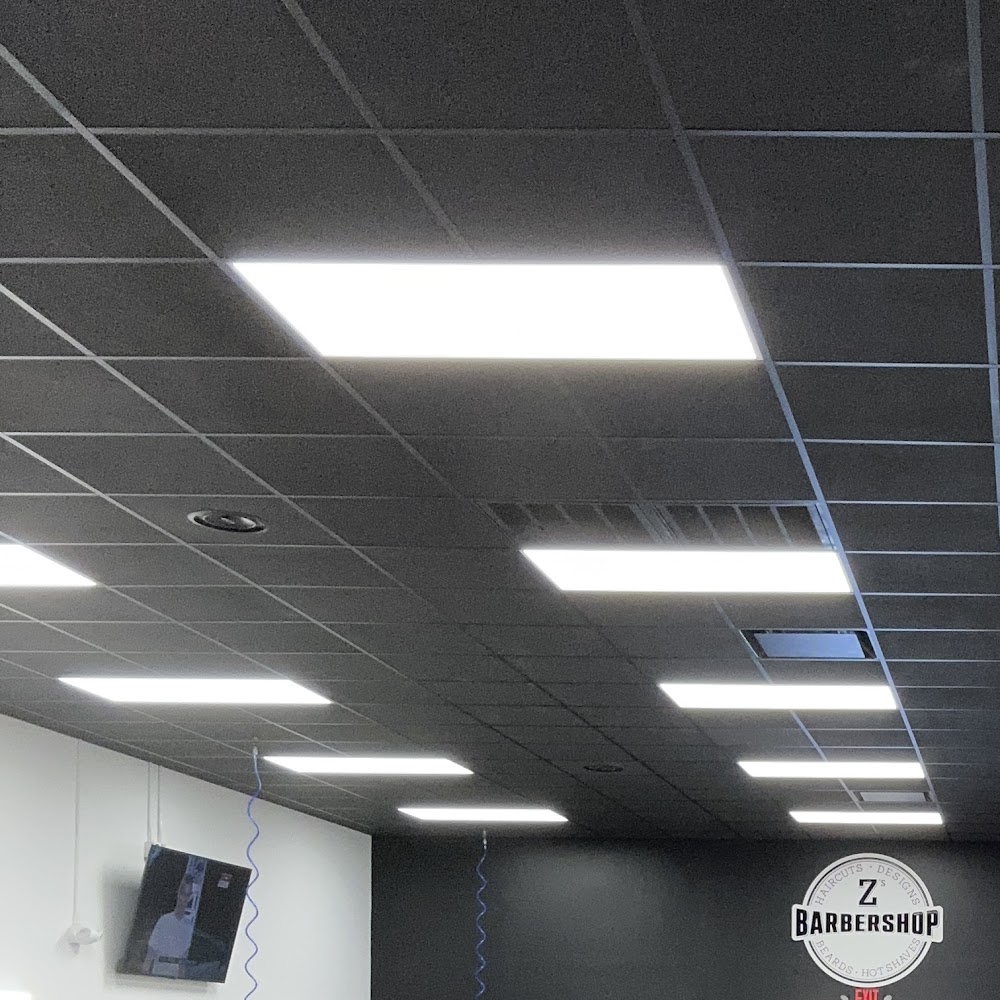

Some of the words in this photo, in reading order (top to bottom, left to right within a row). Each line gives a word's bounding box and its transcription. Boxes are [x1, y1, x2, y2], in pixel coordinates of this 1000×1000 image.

[815, 864, 863, 906] HAIRCUTS
[877, 865, 921, 906] DESIGNS
[796, 908, 939, 937] BARBERSHOP
[816, 940, 853, 975] BEARDS
[861, 967, 884, 977] HOT
[886, 938, 921, 972] SHAVES
